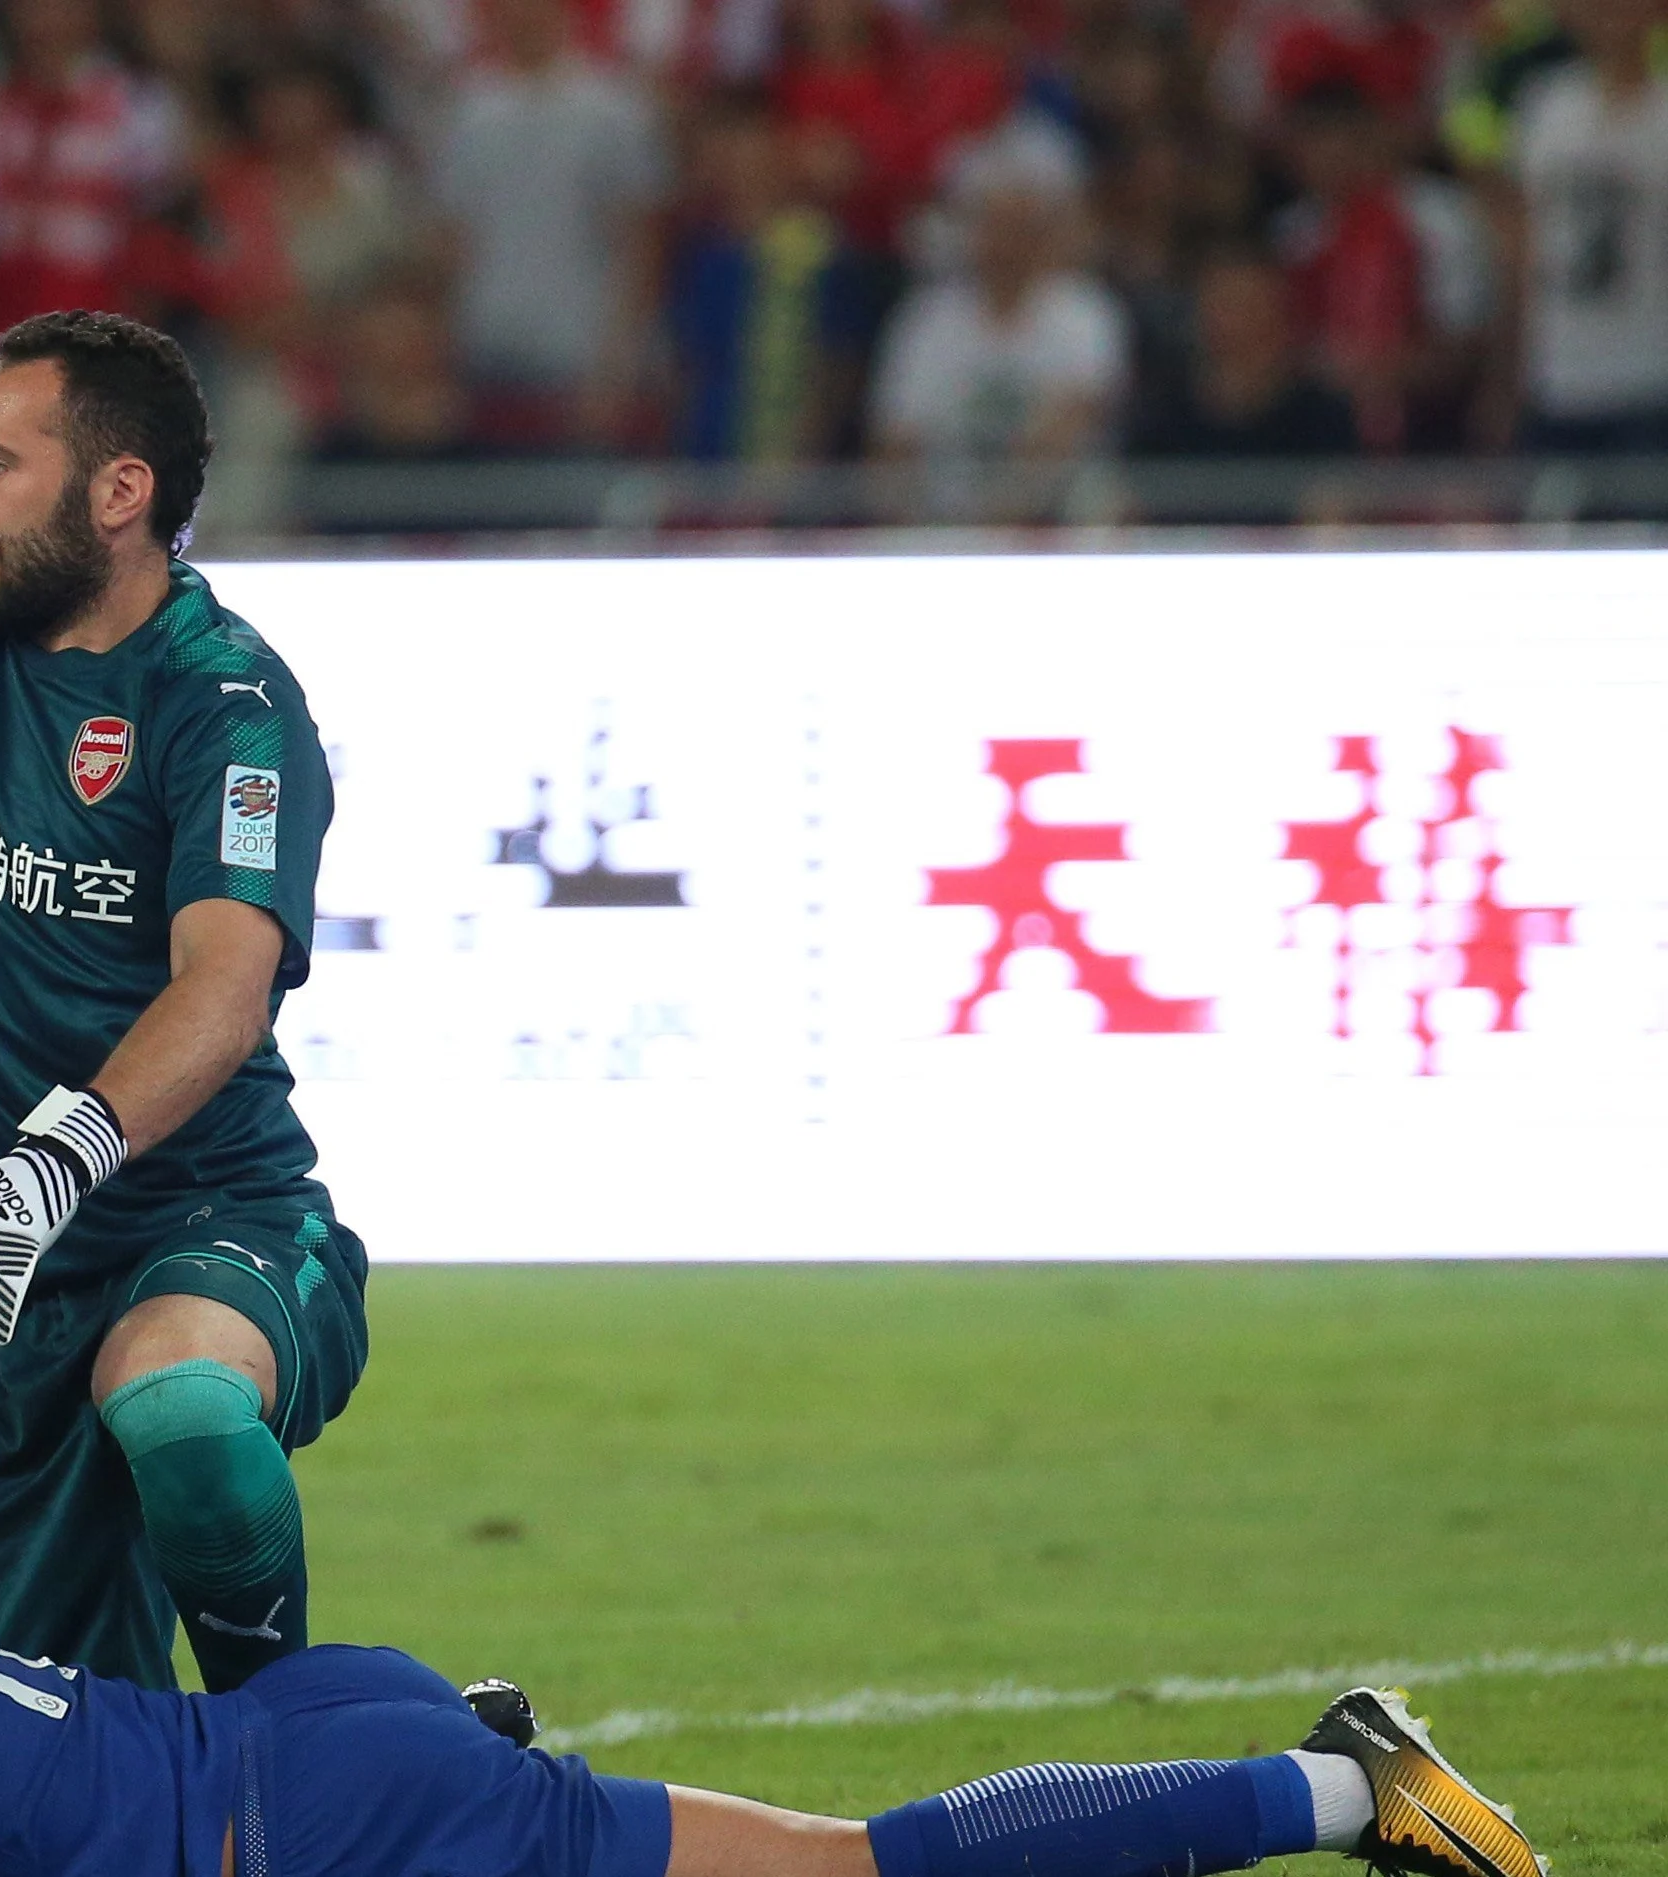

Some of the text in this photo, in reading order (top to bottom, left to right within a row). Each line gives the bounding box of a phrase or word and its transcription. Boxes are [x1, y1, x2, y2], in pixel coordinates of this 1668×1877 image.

[81, 730, 125, 745] Arsenal
[234, 822, 273, 835] TOUR
[229, 834, 277, 854] 2017
[1339, 1708, 1400, 1753] MERCURIAL
